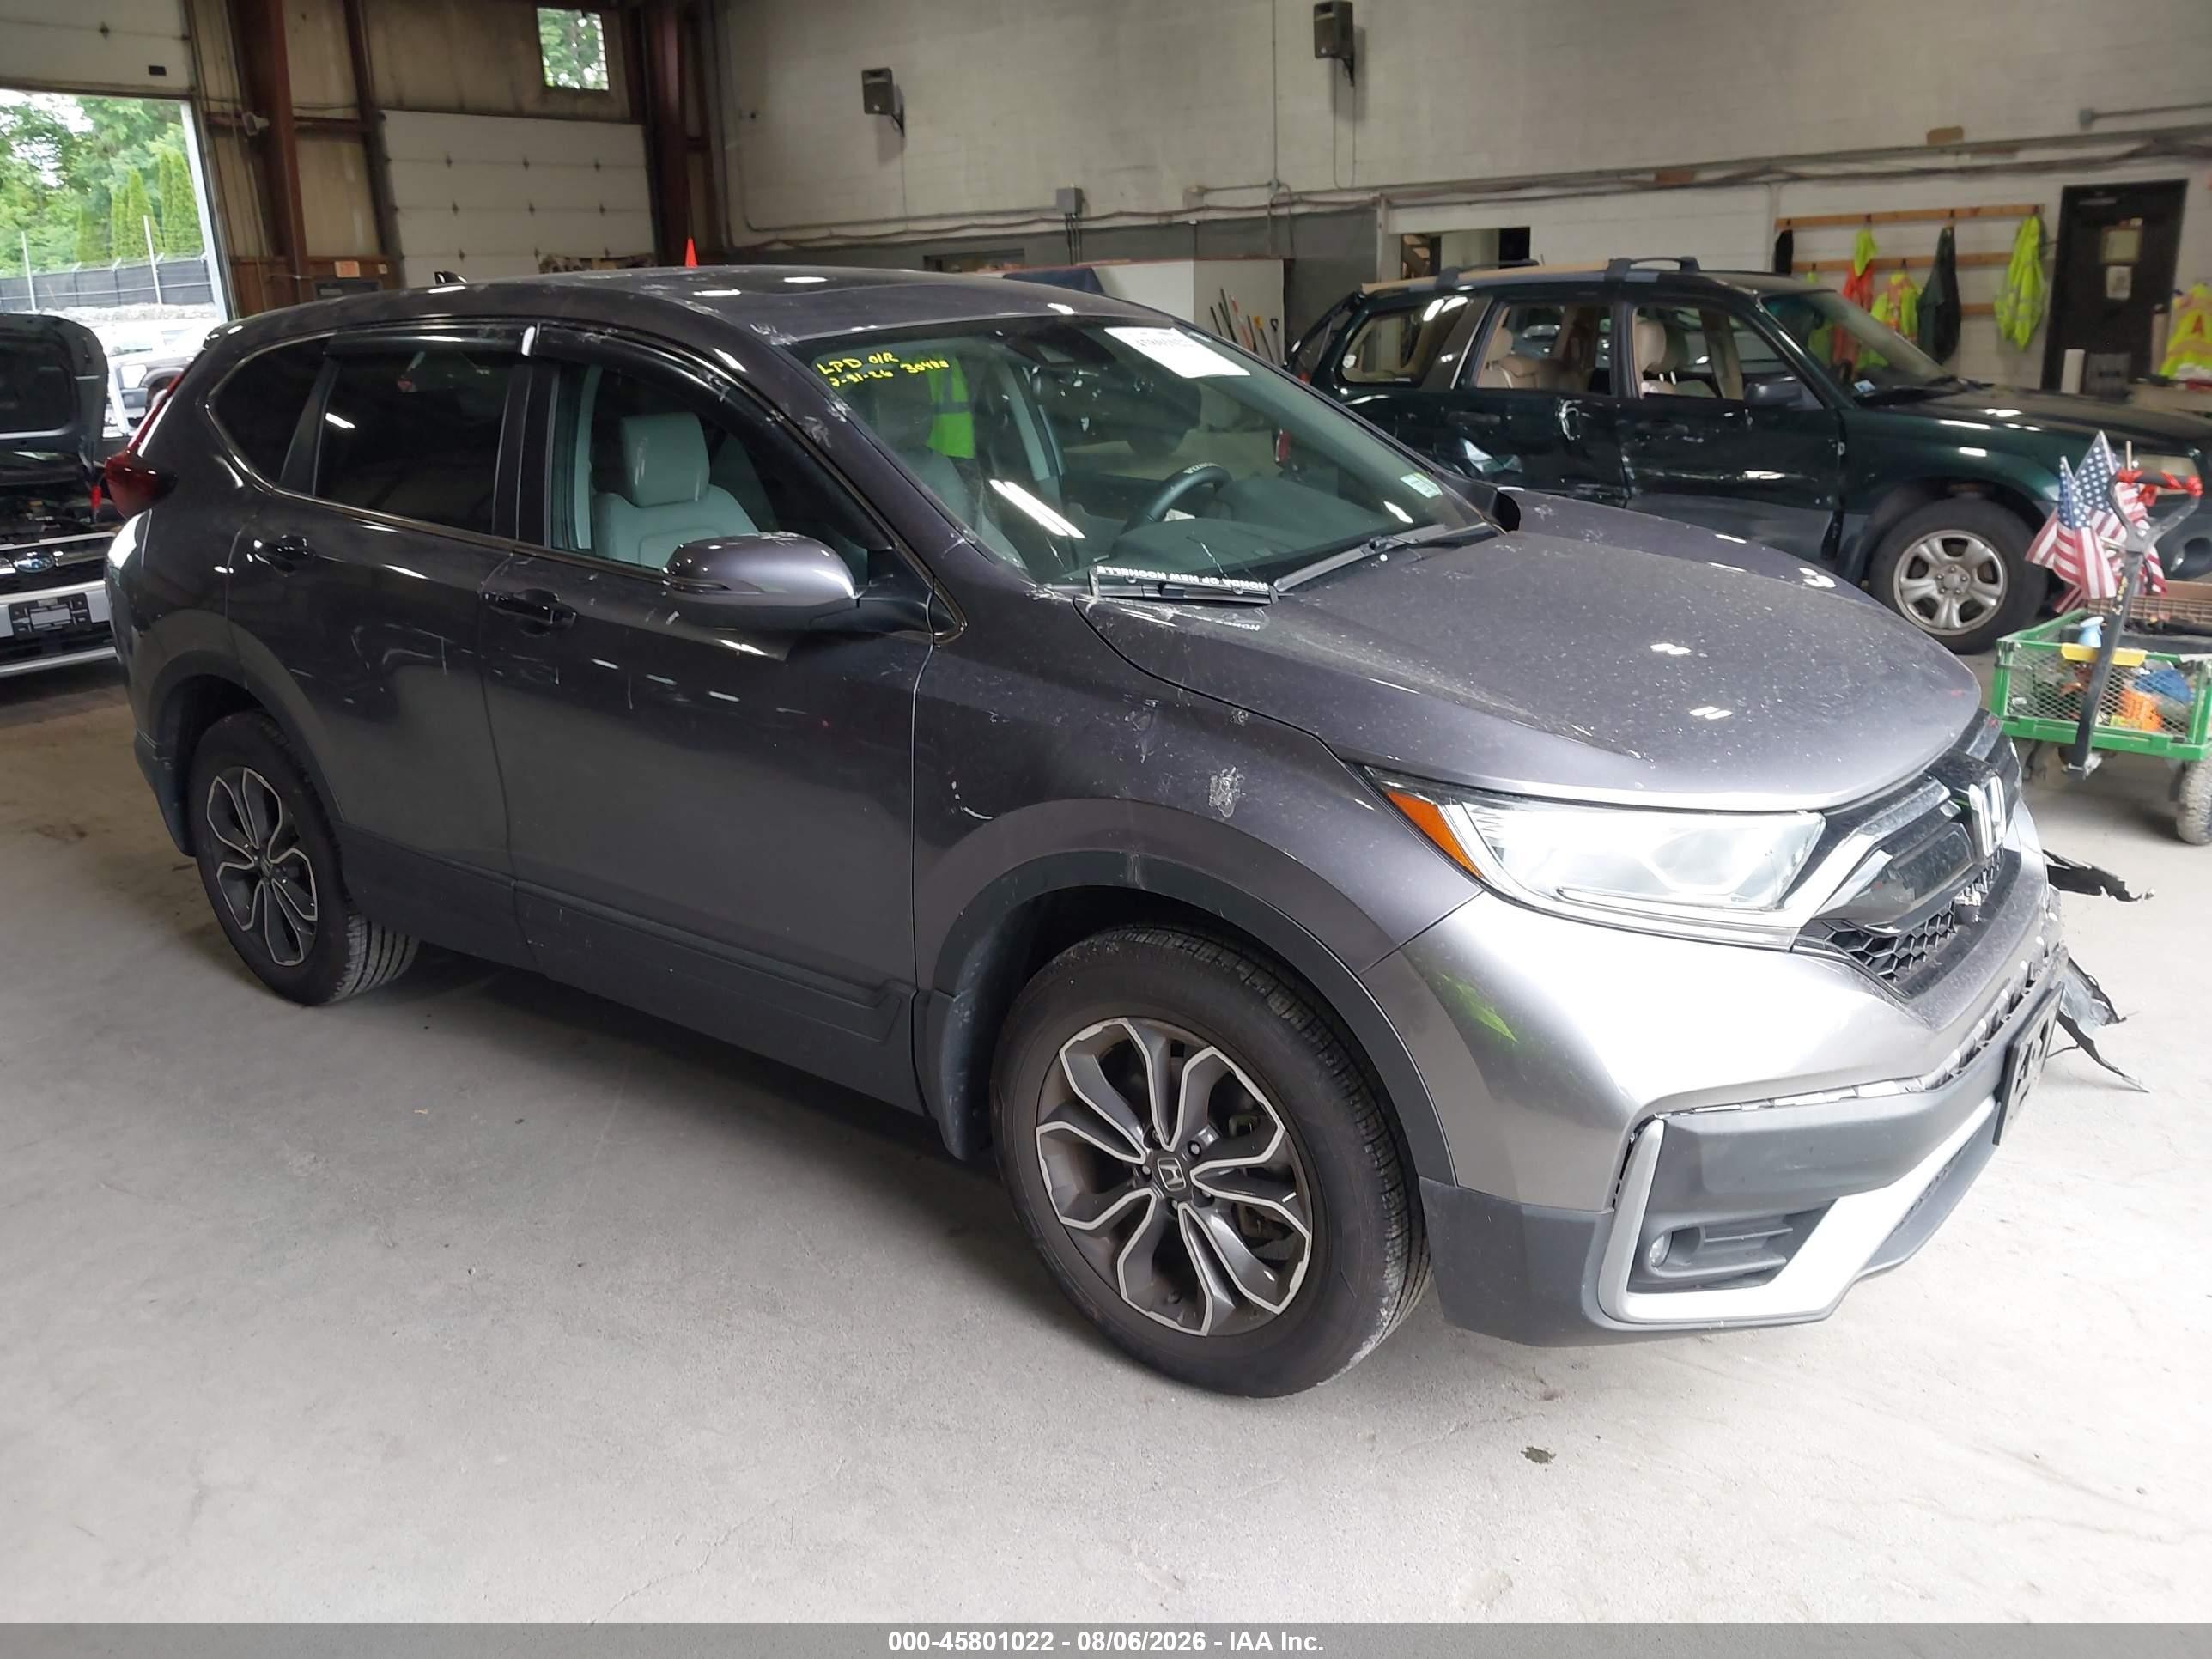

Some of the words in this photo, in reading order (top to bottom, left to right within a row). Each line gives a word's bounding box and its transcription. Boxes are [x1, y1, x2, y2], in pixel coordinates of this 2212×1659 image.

[817, 357, 862, 374] LPD
[1097, 565, 1167, 580] ROCHELLE
[1170, 574, 1200, 584] NEW
[1201, 577, 1220, 586] OF
[1222, 578, 1269, 592] HONDA
